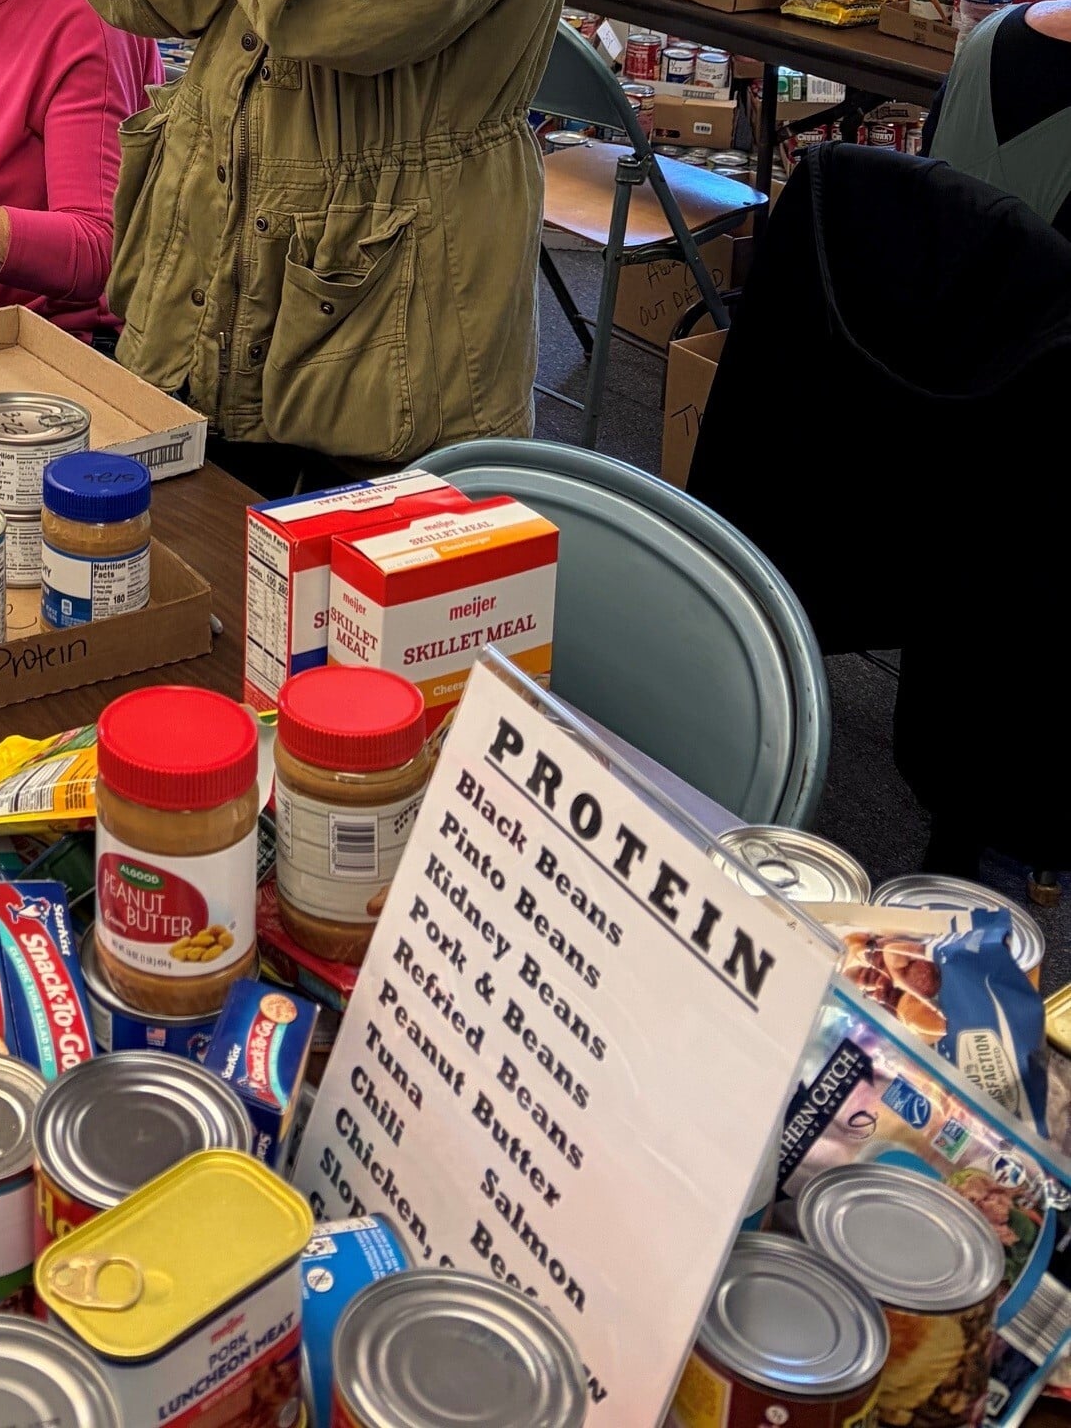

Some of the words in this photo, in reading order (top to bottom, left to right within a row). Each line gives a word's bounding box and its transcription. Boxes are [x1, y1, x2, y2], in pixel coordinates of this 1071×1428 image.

[409, 528, 457, 546] SKILLET
[460, 520, 494, 536] MEAL
[93, 561, 127, 573] Nutrition
[93, 570, 116, 580] Facts
[112, 593, 126, 605] 180
[343, 592, 367, 615] meijer
[449, 595, 496, 622] meijer
[331, 606, 378, 651] SKILLET
[336, 628, 369, 662] MEAL
[403, 631, 481, 666] SKILLET
[486, 614, 537, 644] MEAL
[119, 864, 160, 885] ALGOOD
[456, 768, 529, 855] Black
[535, 845, 625, 949] Beans
[485, 715, 776, 1002] PROTEIN
[103, 868, 166, 915] PEANUT
[439, 810, 506, 893] Pinto
[514, 886, 601, 991] Beans
[53, 902, 71, 956] StarKist
[126, 906, 193, 937] BUTTER
[424, 853, 512, 963] Kidney
[519, 952, 609, 1063] Beans
[409, 895, 469, 974] Pork
[474, 972, 496, 1006] &
[502, 998, 590, 1110] Beans
[393, 937, 486, 1056] Refried
[497, 1055, 585, 1171] Beans
[351, 1065, 406, 1148] Chili
[378, 978, 467, 1098] Peanut
[471, 1090, 562, 1209] Butter
[335, 1106, 433, 1261] Chicken,
[366, 1020, 425, 1111] Tuna
[480, 1167, 587, 1314] Salmon
[158, 1350, 251, 1422] LUNCHEON
[255, 1312, 295, 1352] MEAT
[207, 1330, 249, 1370] PORK
